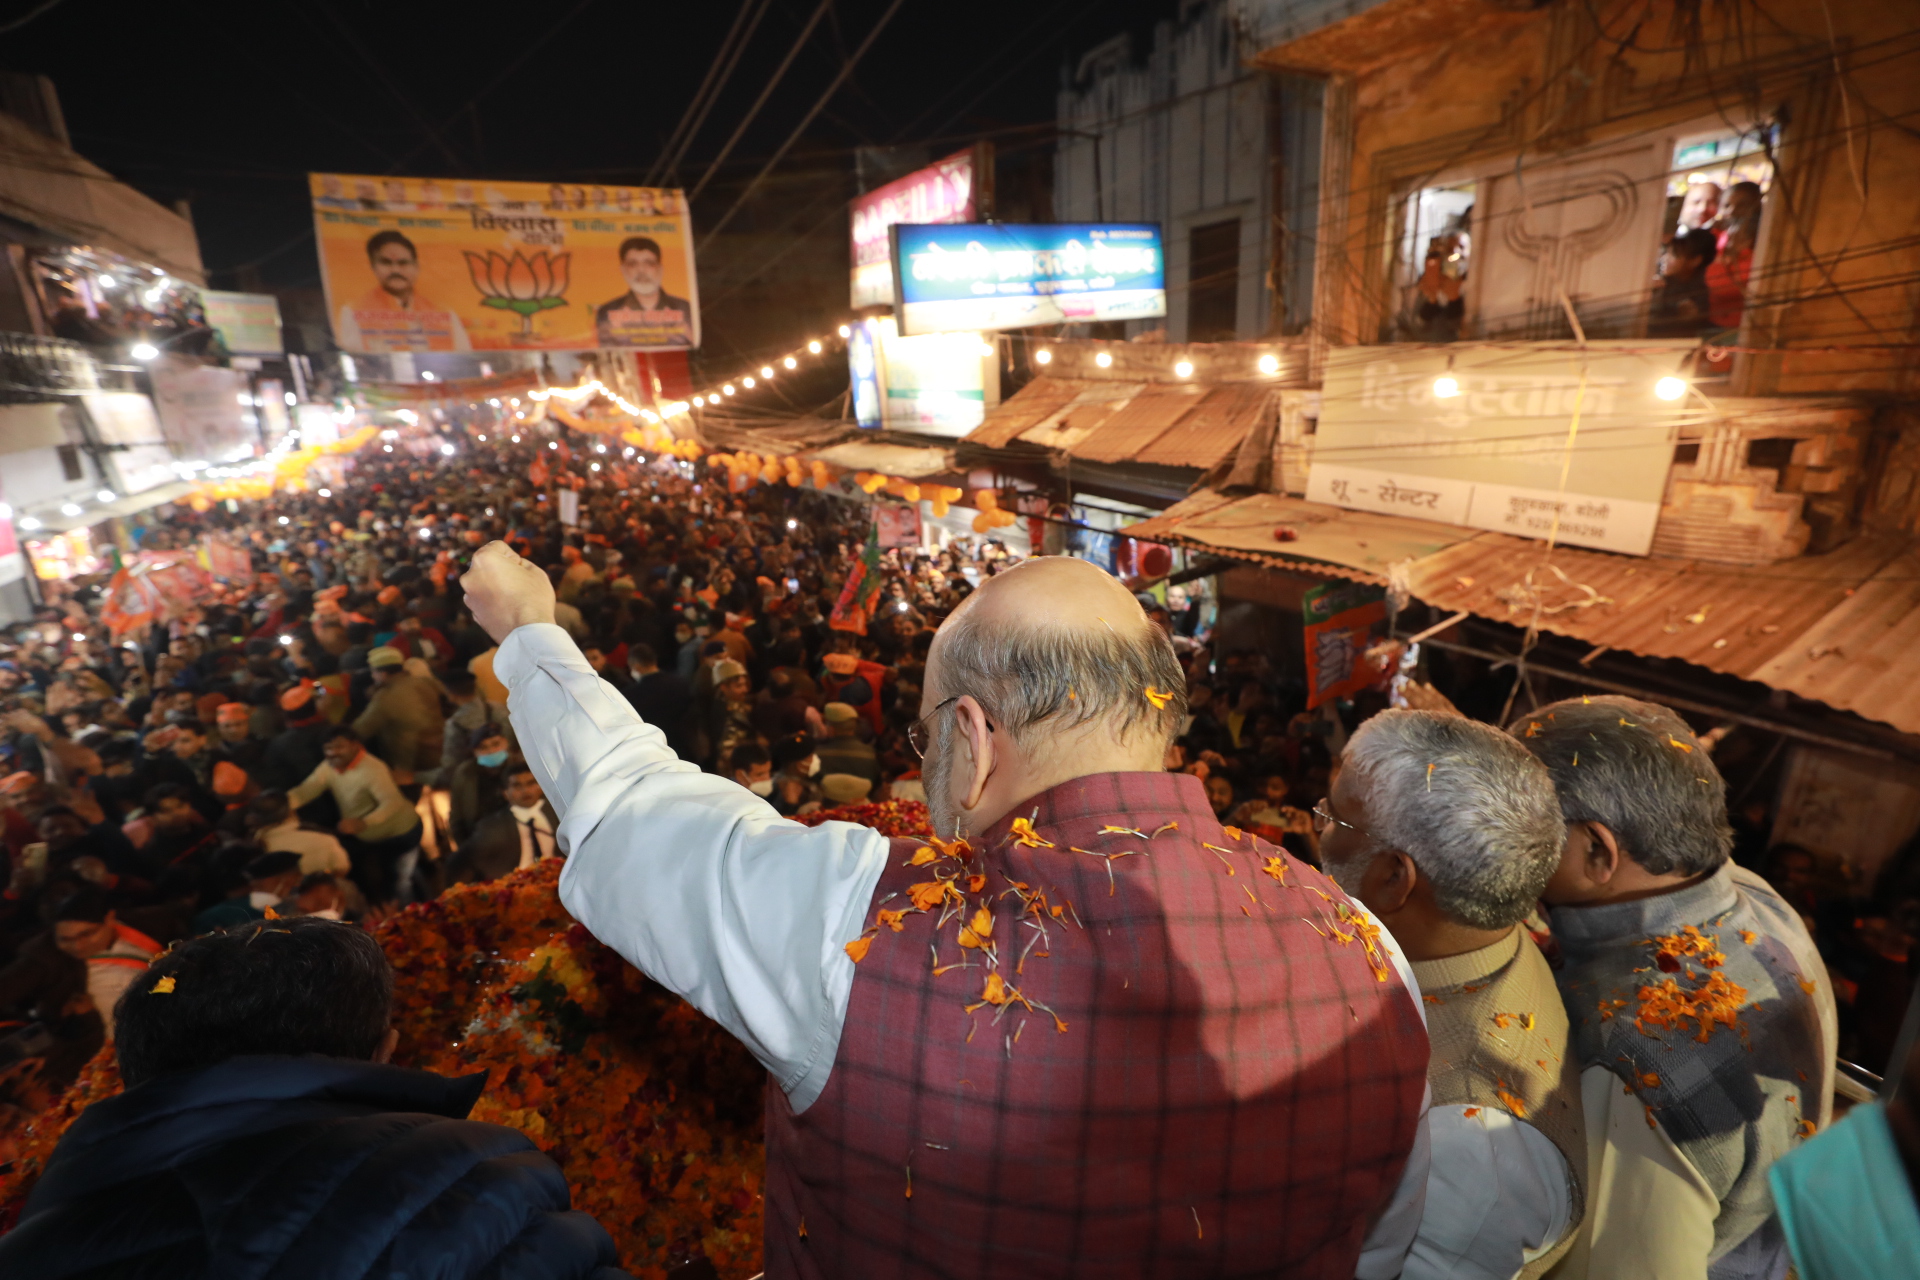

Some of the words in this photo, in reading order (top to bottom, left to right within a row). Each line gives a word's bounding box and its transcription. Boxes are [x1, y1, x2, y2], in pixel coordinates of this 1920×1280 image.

[471, 207, 557, 232] विश्वास
[1330, 479, 1351, 502] शू
[1378, 478, 1443, 509] सेन्टर
